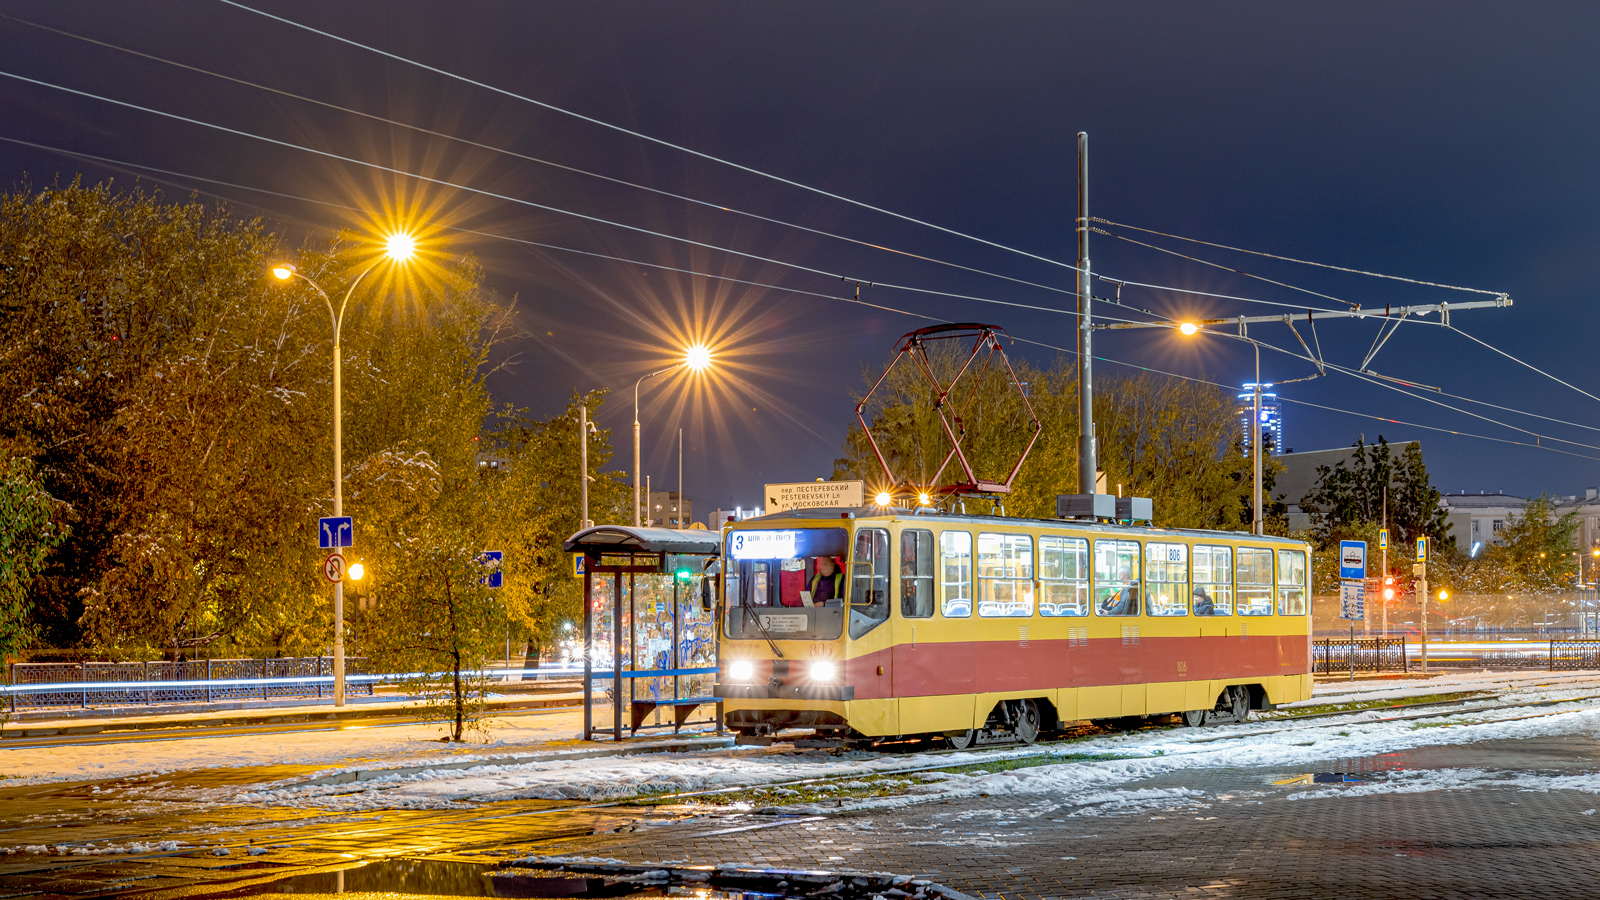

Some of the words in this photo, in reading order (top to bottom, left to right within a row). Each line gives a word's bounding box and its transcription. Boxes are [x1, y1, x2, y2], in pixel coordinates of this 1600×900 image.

[796, 484, 849, 492] ПЕСТЕРЕВСКИЙ
[736, 535, 744, 550] 3
[1169, 549, 1180, 561] 806
[765, 616, 771, 630] 3
[809, 643, 833, 656] 806
[1177, 661, 1187, 672] 806
